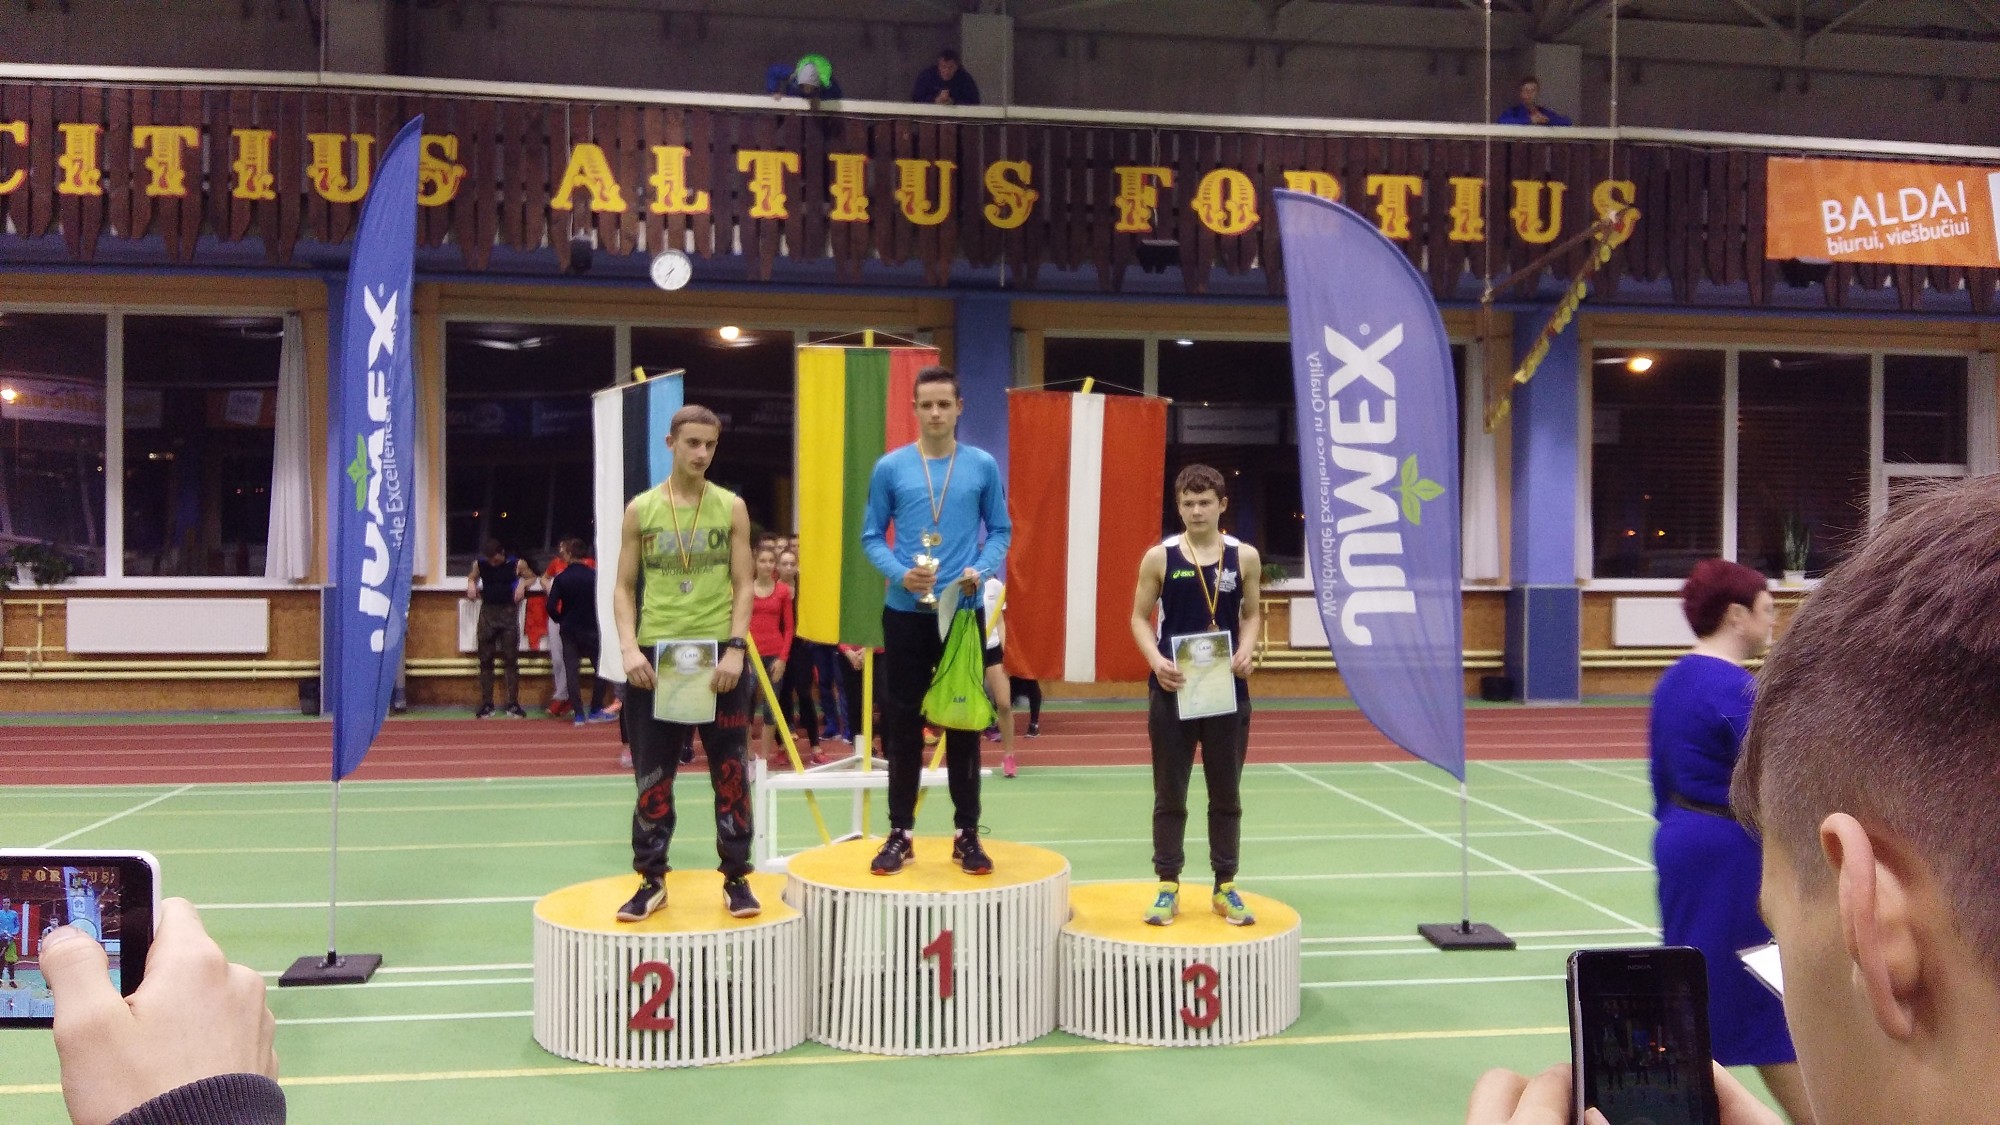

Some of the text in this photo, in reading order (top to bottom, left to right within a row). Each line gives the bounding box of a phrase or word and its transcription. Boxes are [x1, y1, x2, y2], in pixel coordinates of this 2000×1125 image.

[550, 142, 1039, 229] ALTIUS
[1821, 179, 1967, 235] BALDAI
[1825, 216, 1971, 256] biurui, viešbučiui
[628, 961, 676, 1032] 2
[923, 929, 954, 1000] 1
[1180, 963, 1221, 1030] 3
